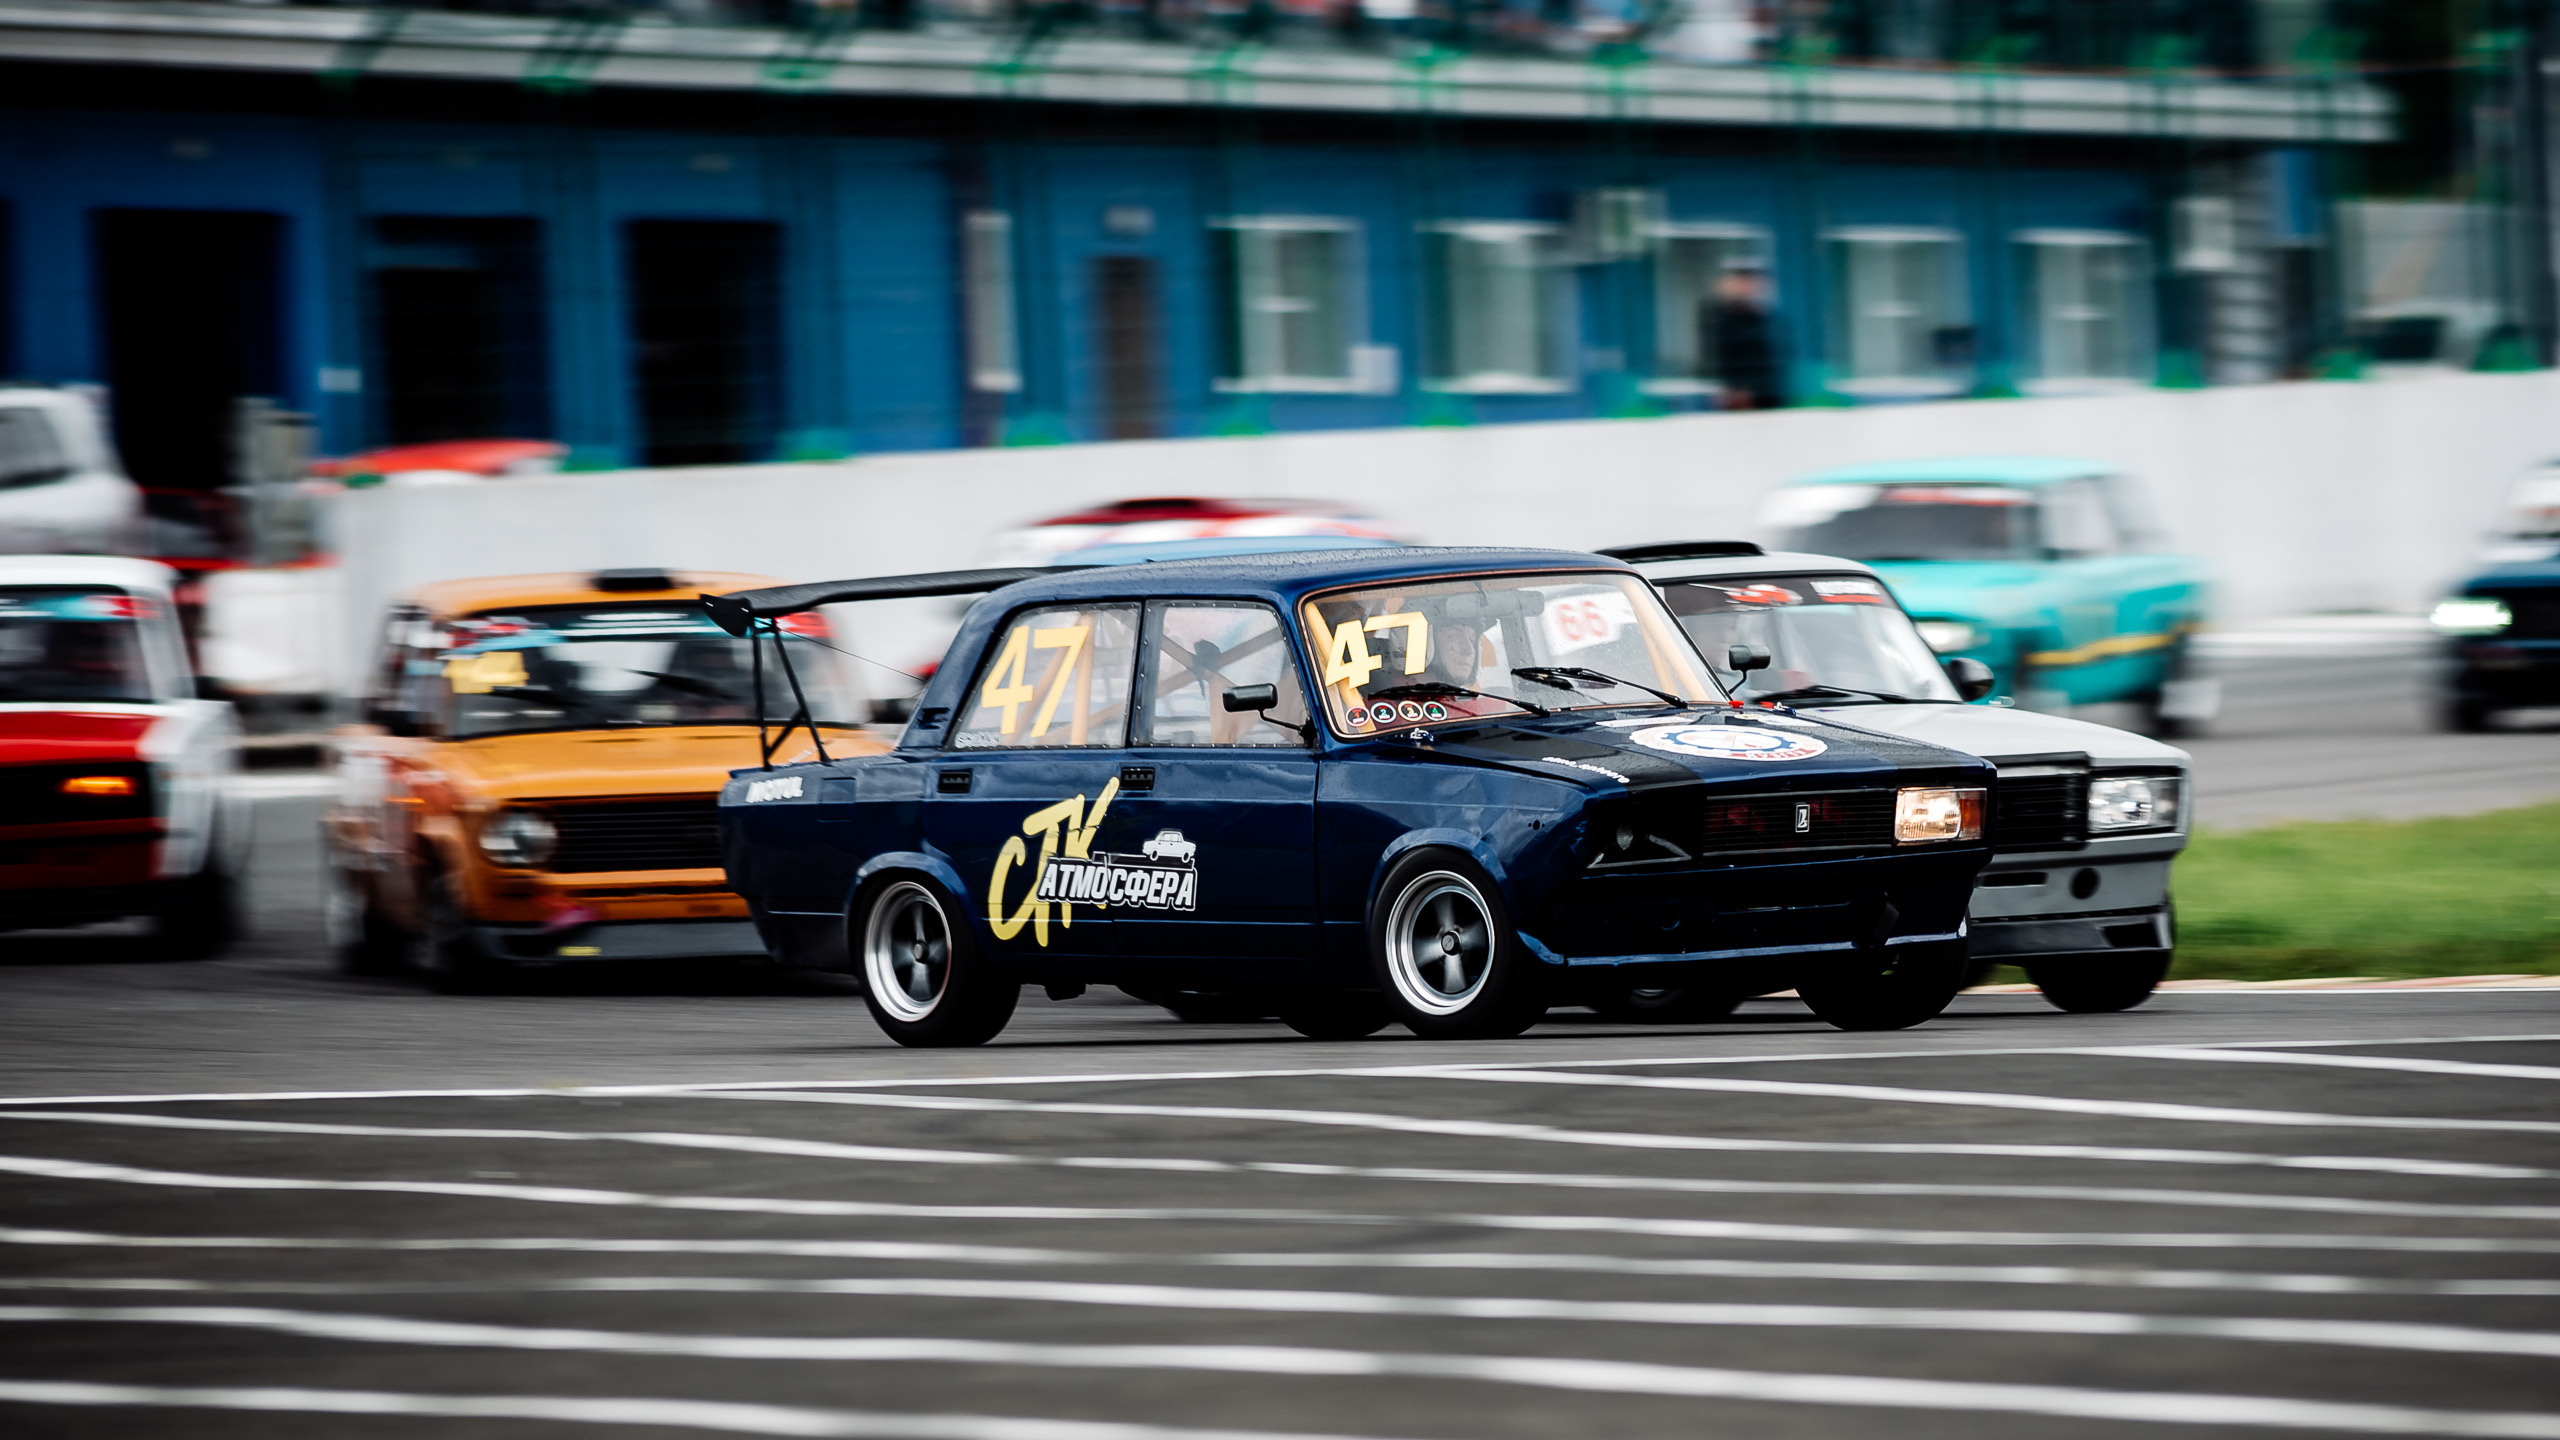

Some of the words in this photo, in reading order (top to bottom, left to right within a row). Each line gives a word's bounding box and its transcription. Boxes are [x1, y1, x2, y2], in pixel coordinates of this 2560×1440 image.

[1557, 601, 1608, 641] 66
[1325, 611, 1428, 689] 47
[981, 625, 1089, 738] 47
[745, 776, 803, 803] MOTUL
[1038, 863, 1195, 906] АТМОСФЕРА
